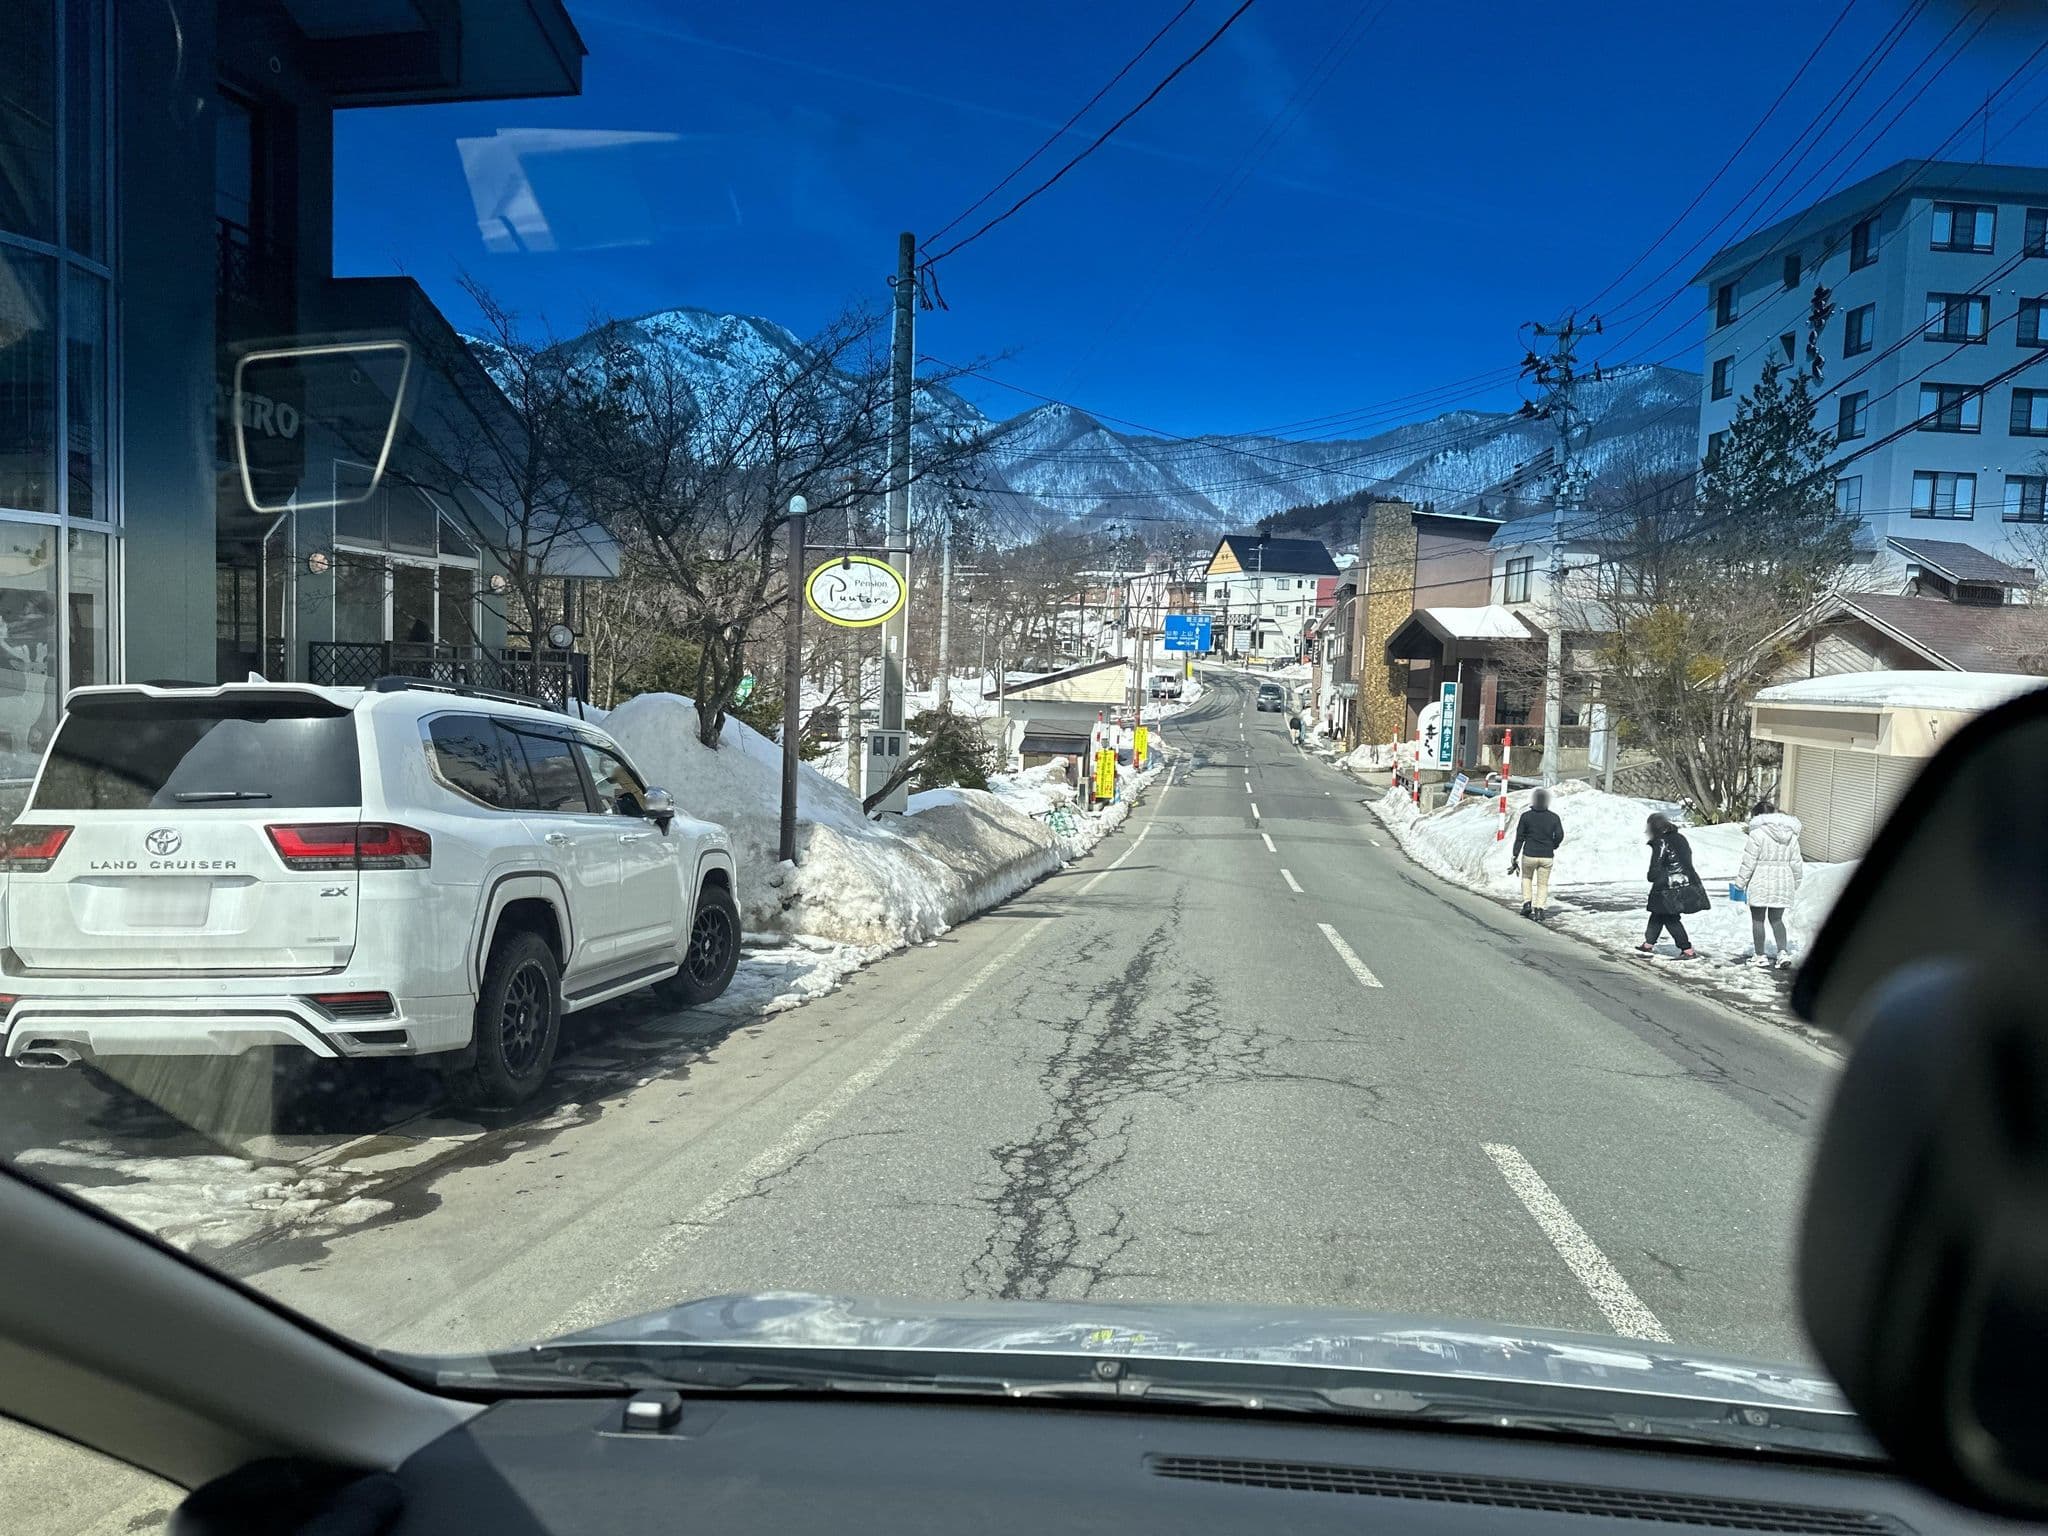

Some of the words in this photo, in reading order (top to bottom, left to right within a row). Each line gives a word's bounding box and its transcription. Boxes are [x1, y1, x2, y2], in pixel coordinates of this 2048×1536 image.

[854, 579, 888, 588] Pension
[90, 860, 138, 870] LAND
[150, 860, 237, 870] CRUISER
[320, 886, 350, 898] ZX
